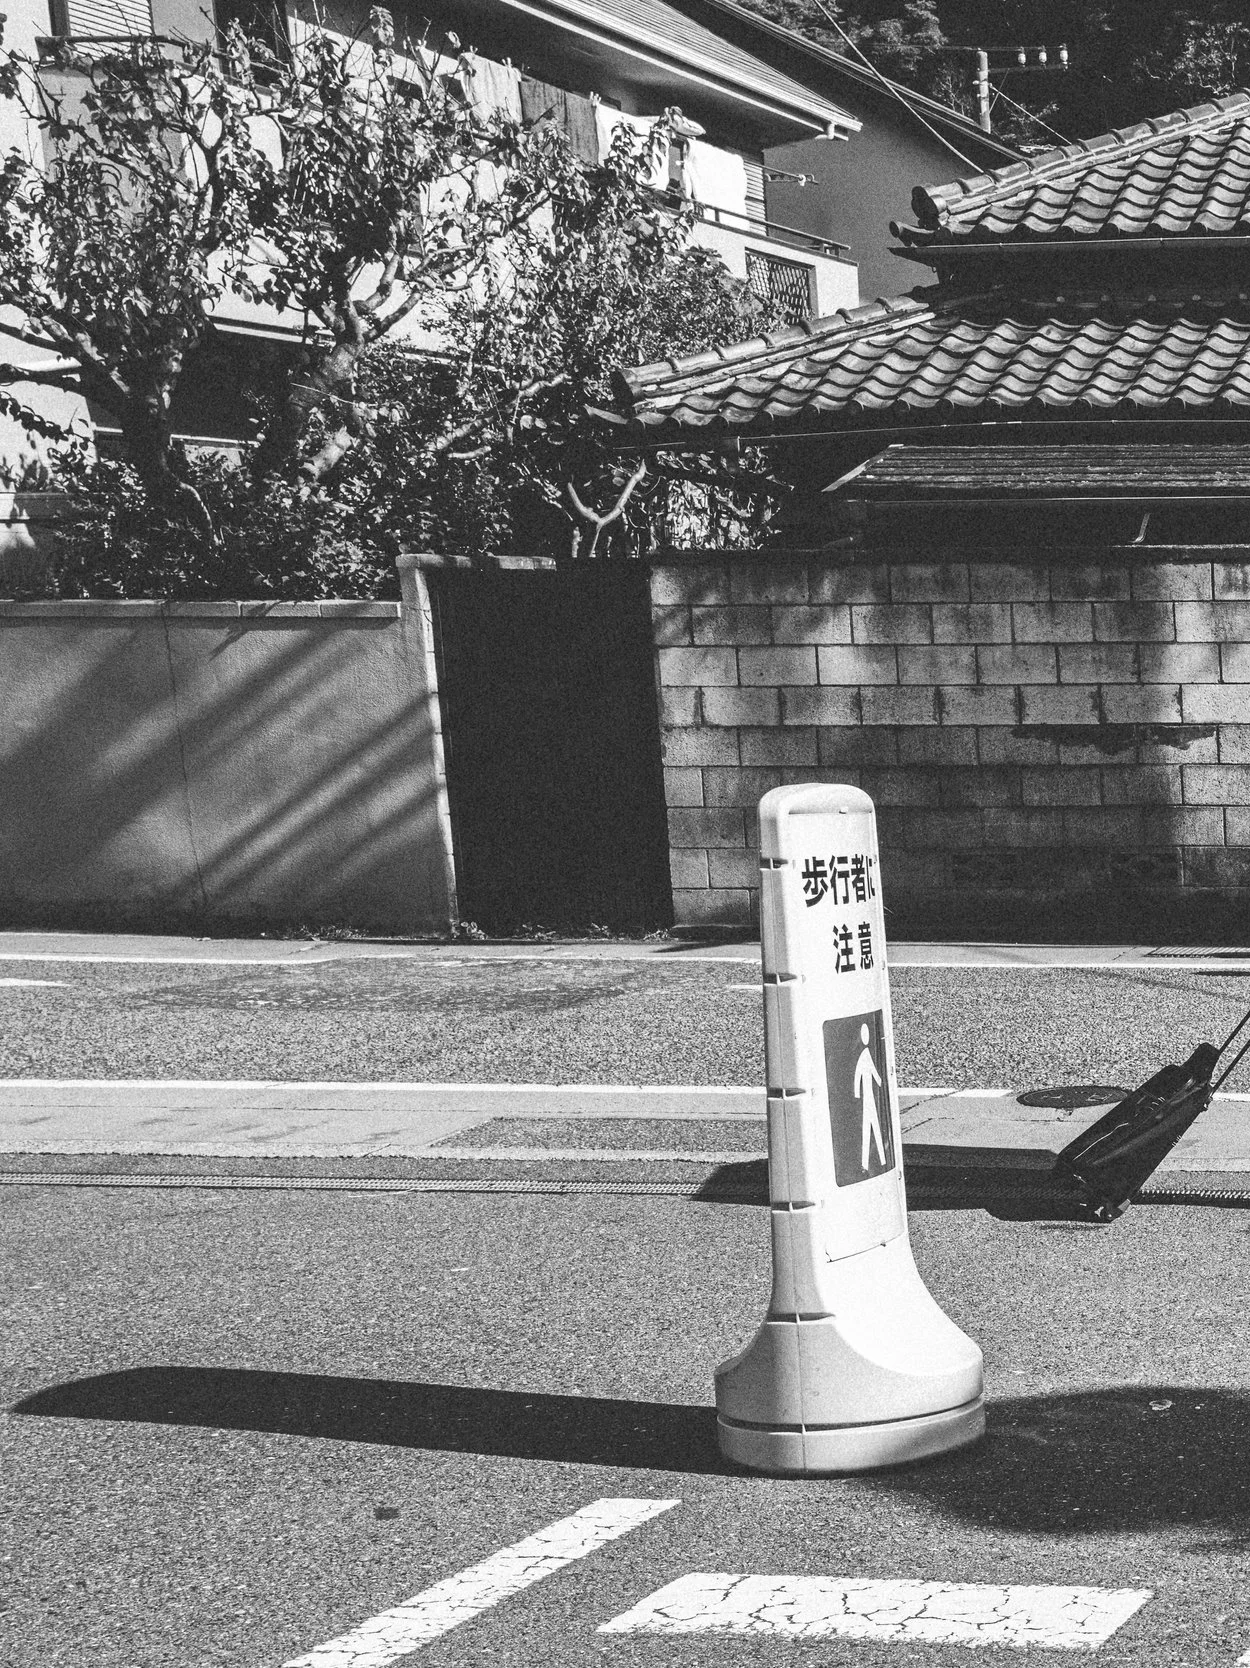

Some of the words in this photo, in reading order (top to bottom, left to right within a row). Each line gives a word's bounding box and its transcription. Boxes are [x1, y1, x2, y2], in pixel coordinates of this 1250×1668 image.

[801, 853, 876, 908] 歩行者に
[832, 921, 875, 975] 注意
